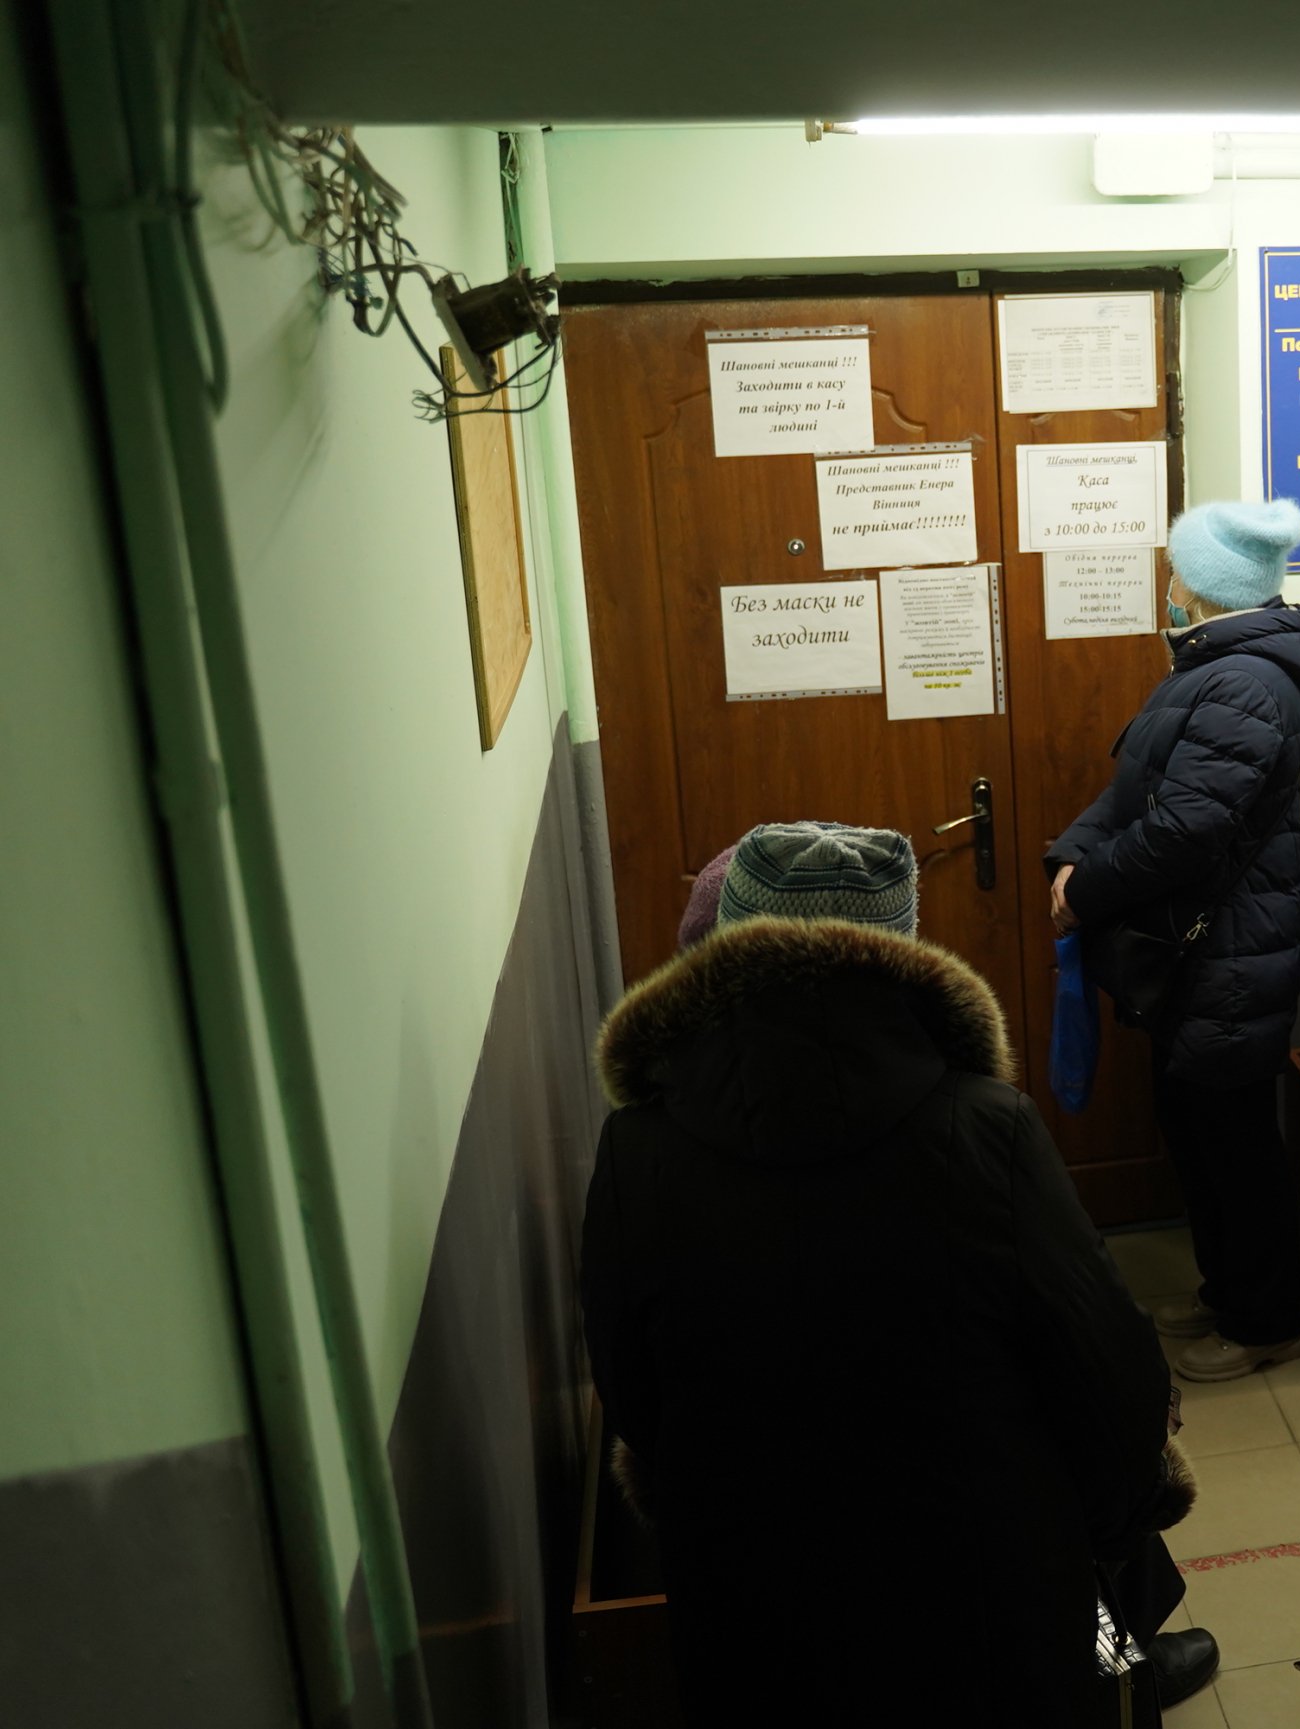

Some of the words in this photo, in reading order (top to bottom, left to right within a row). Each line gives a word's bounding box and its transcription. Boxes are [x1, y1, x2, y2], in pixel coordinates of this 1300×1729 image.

[720, 360, 776, 372] Шановні
[778, 358, 838, 371] мешканці
[736, 380, 802, 393] Заходити
[806, 382, 814, 390] в
[817, 378, 846, 392] касу
[738, 404, 758, 414] та
[762, 402, 801, 416] звірку
[805, 403, 821, 412] по
[825, 400, 846, 411] 1-й
[769, 420, 818, 434] людині
[1046, 455, 1089, 466] Шановні
[828, 464, 881, 477] Шановні
[884, 461, 942, 474] мешканці
[836, 482, 917, 497] Представник
[918, 480, 955, 493] Енера
[1077, 474, 1110, 489] Каса
[872, 499, 921, 511] Вінниця
[1071, 500, 1119, 515] працює
[832, 525, 850, 536] не
[1044, 527, 1051, 536] з
[1055, 523, 1090, 536] 10:00
[1093, 521, 1108, 534] до
[1111, 520, 1146, 534] 15:00
[1077, 567, 1097, 575] 12:00
[1104, 566, 1125, 574] 13:00
[730, 595, 767, 614] Без
[772, 595, 837, 614] маски
[843, 593, 865, 608] не
[751, 625, 850, 650] заходити
